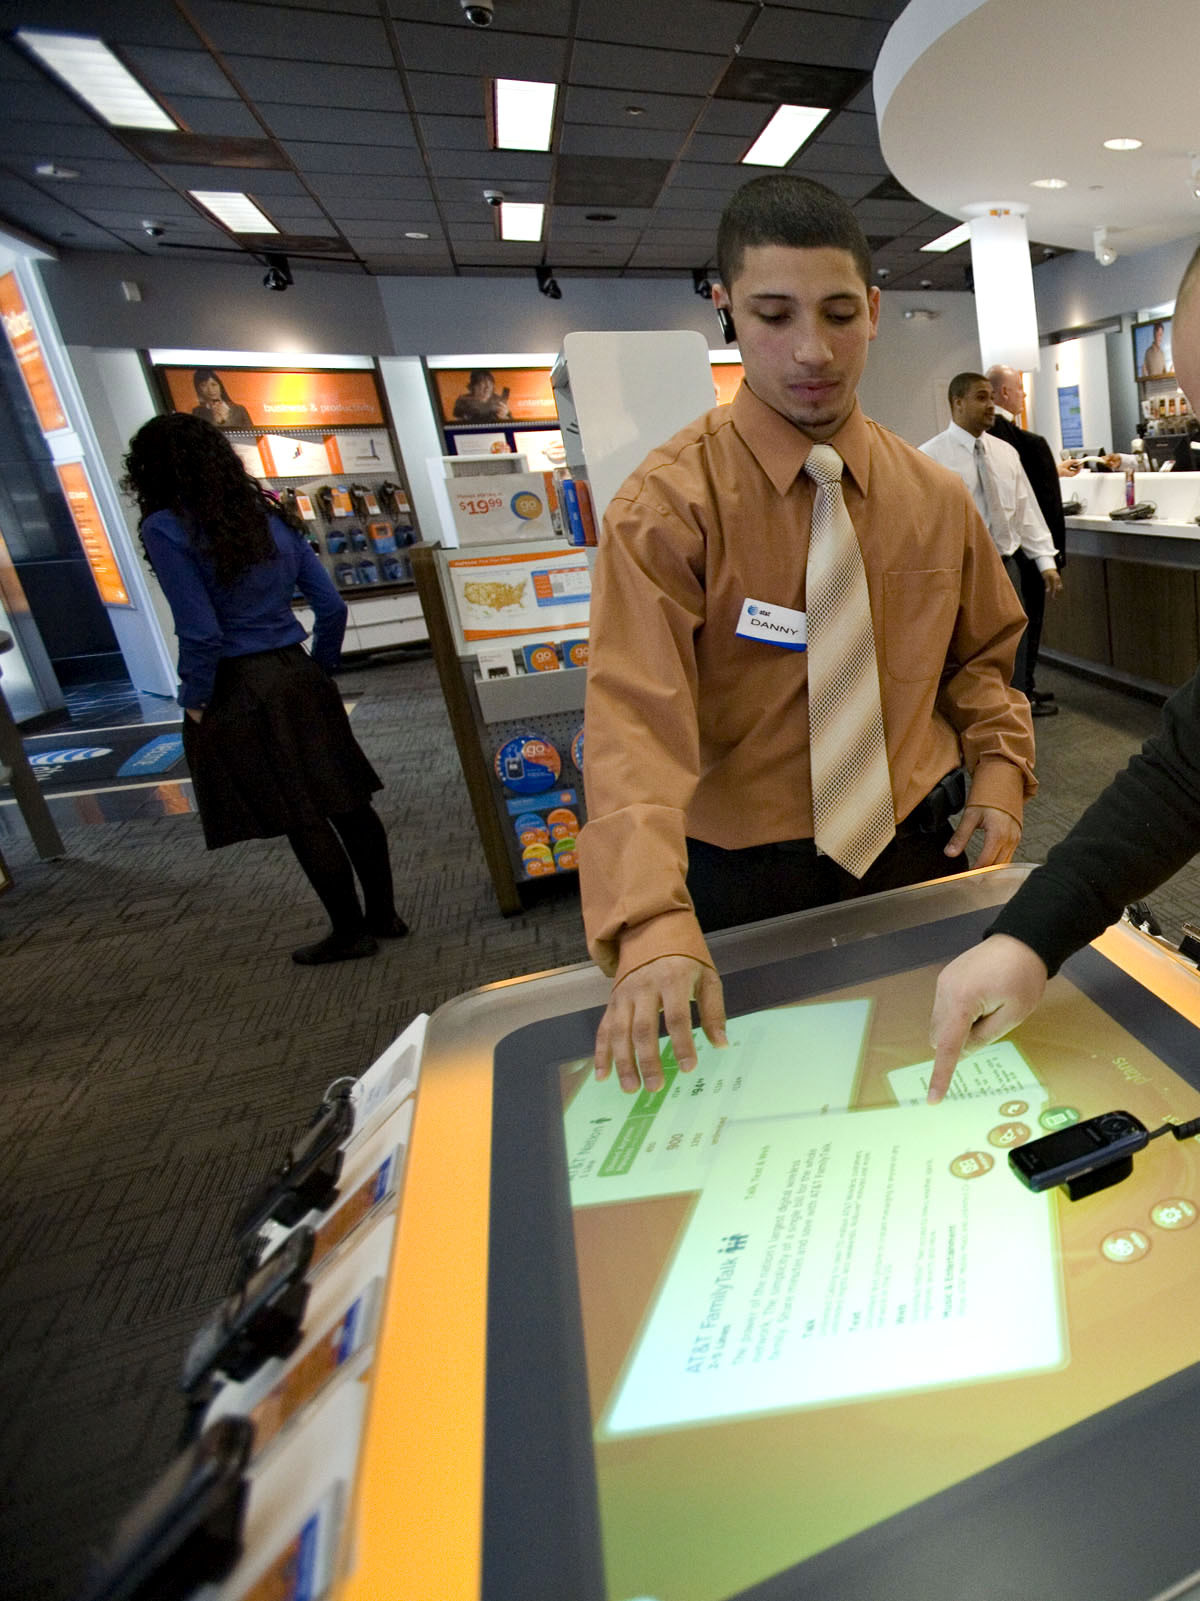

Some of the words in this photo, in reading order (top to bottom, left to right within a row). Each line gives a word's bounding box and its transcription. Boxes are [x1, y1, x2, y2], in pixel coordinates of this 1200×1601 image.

[750, 618, 799, 636] DANNY
[535, 651, 552, 663] go
[526, 745, 545, 758] go
[686, 1334, 711, 1373] AT&T
